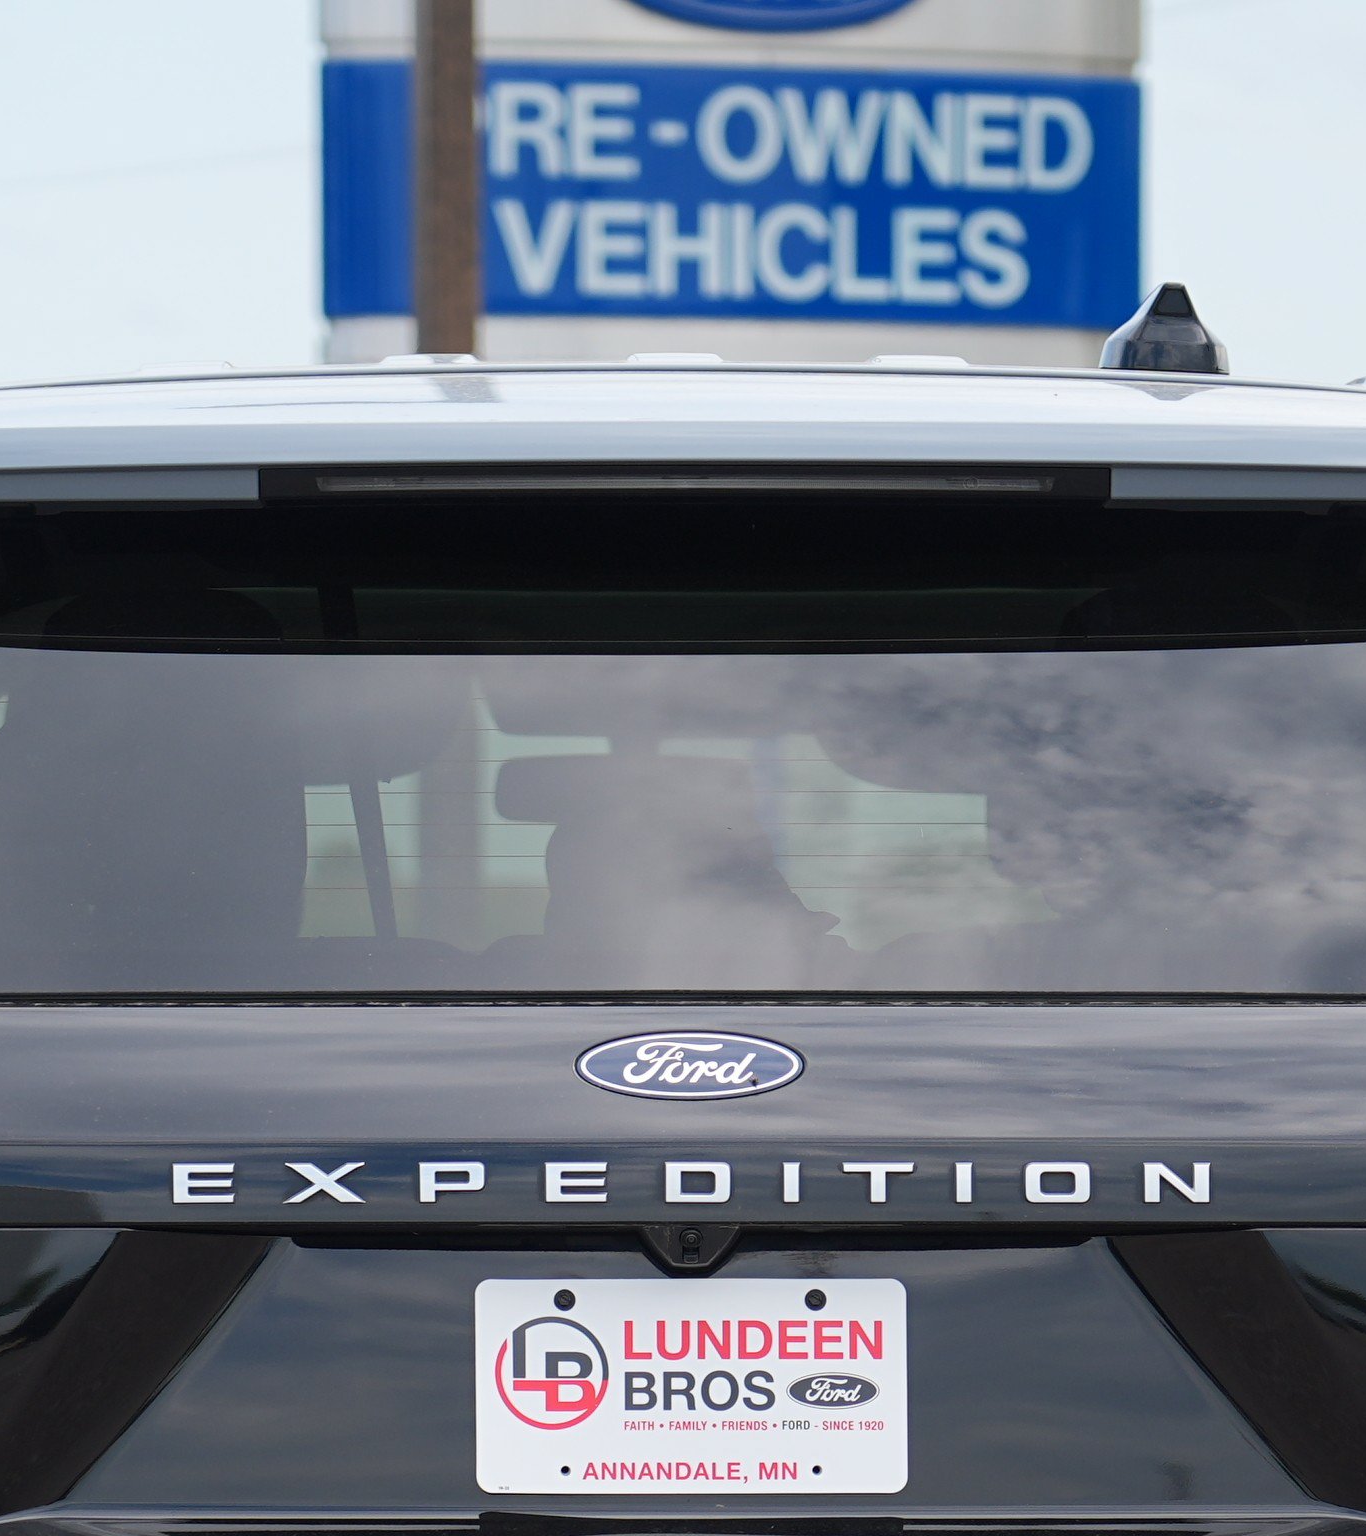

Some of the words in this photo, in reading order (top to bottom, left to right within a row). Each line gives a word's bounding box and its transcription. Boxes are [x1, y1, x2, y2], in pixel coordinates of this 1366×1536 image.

[475, 82, 1094, 191] RE-OWNED
[493, 200, 1030, 308] VEHICLES
[623, 1041, 756, 1084] Ford
[171, 1161, 1211, 1204] EXPEDITION
[623, 1319, 884, 1361] LUNDEEN
[623, 1370, 776, 1412] BROS
[804, 1377, 861, 1403] Ford
[623, 1420, 655, 1431] FAITH
[668, 1420, 708, 1431] FAMILY
[721, 1420, 768, 1431] FRIENDS
[781, 1420, 811, 1431] FORD
[821, 1420, 855, 1431] SINCE
[858, 1420, 884, 1431] 1920
[582, 1462, 749, 1483] ANNANDALE,
[758, 1462, 798, 1481] MN
